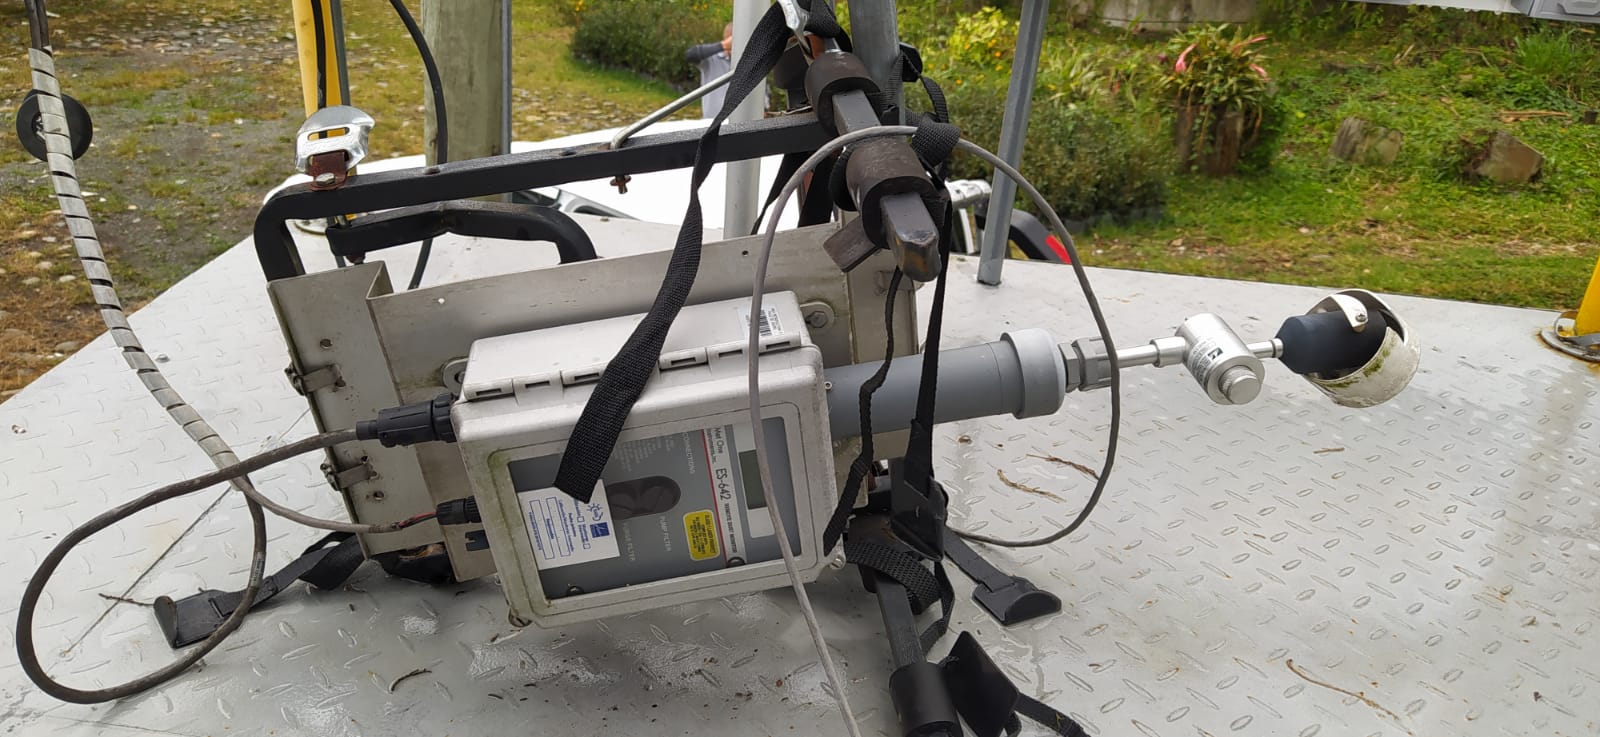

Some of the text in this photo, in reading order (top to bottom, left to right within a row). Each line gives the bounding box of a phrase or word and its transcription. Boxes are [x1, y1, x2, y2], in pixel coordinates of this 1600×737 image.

[714, 427, 725, 454] Met One
[716, 468, 731, 501] ES-642
[663, 533, 672, 551] FILTER
